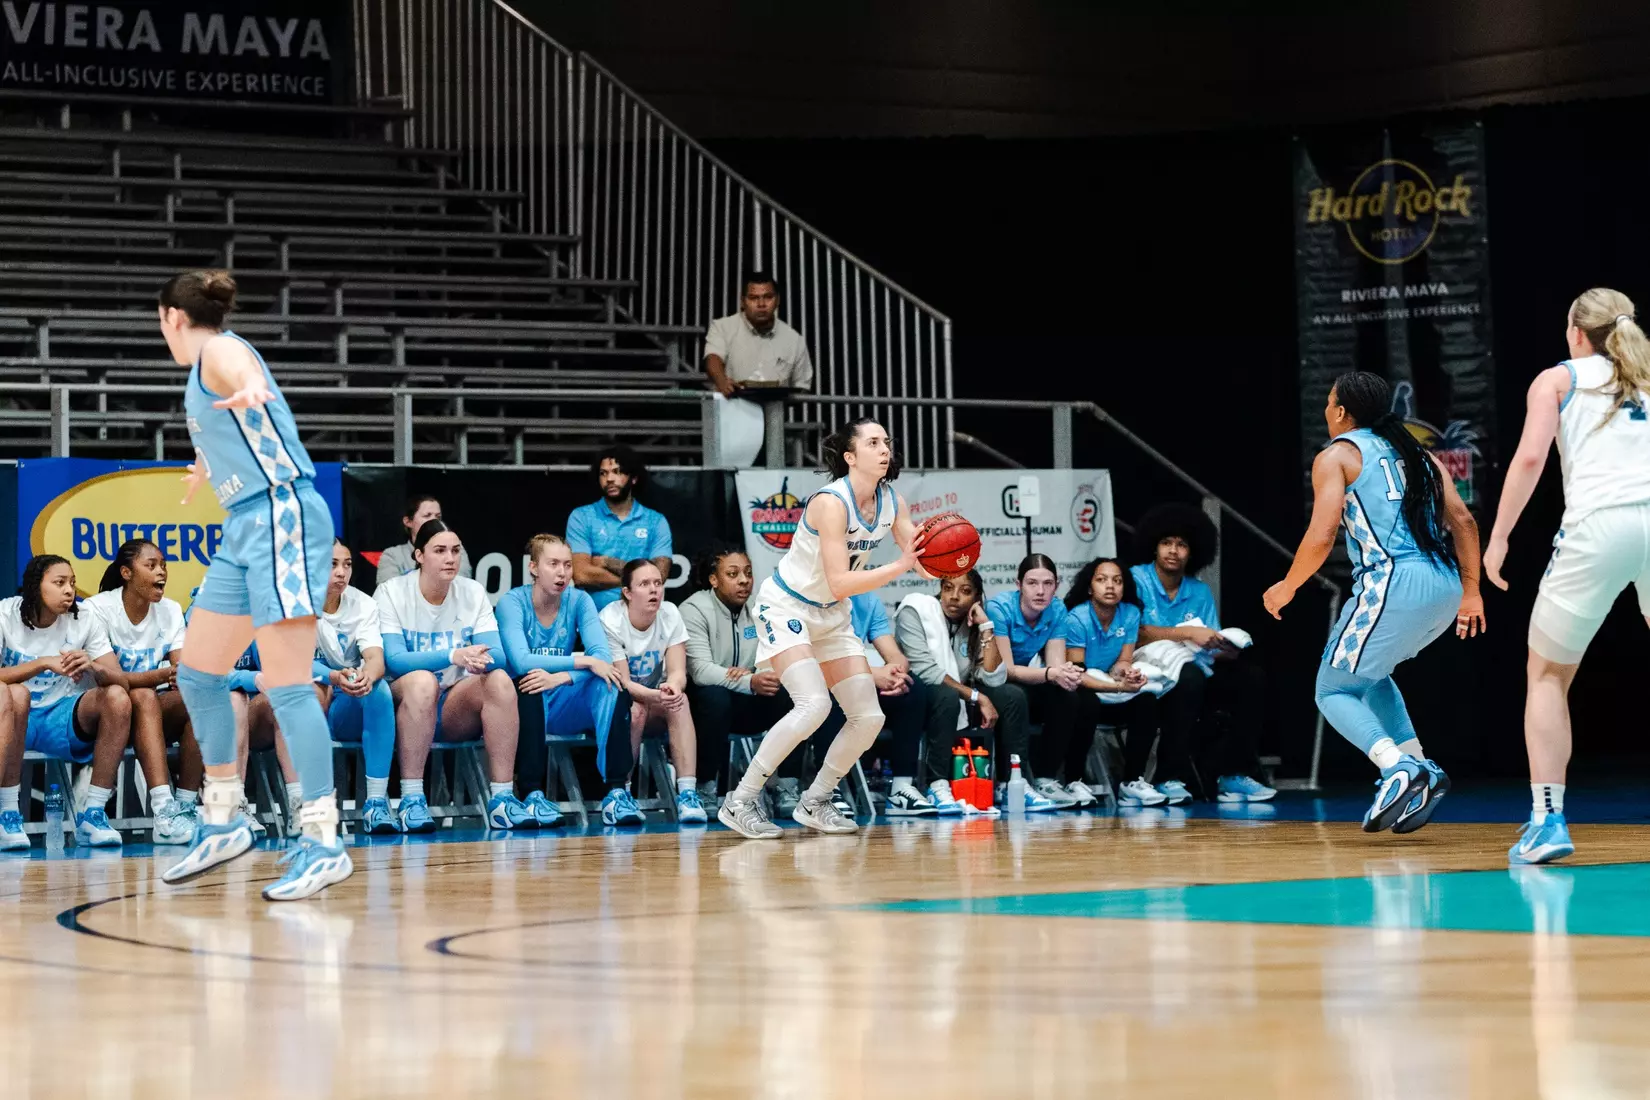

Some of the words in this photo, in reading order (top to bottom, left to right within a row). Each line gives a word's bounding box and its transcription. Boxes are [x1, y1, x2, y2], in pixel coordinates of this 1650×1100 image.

[2, 1, 162, 51] VIERA
[181, 12, 331, 60] MAYA
[2, 60, 177, 90] ALL-INCLUSIVE
[185, 70, 325, 96] EXPERIENCE
[1307, 181, 1390, 223] Hard
[1394, 174, 1472, 221] Rock
[1371, 228, 1414, 242] HOTEL
[1341, 285, 1400, 303] RIVIERA
[1404, 282, 1449, 298] MAYA
[1413, 303, 1481, 318] EXPERIENCE
[910, 496, 942, 514] PROUD
[944, 492, 958, 505] TO
[979, 526, 1027, 537] FFICIALLY
